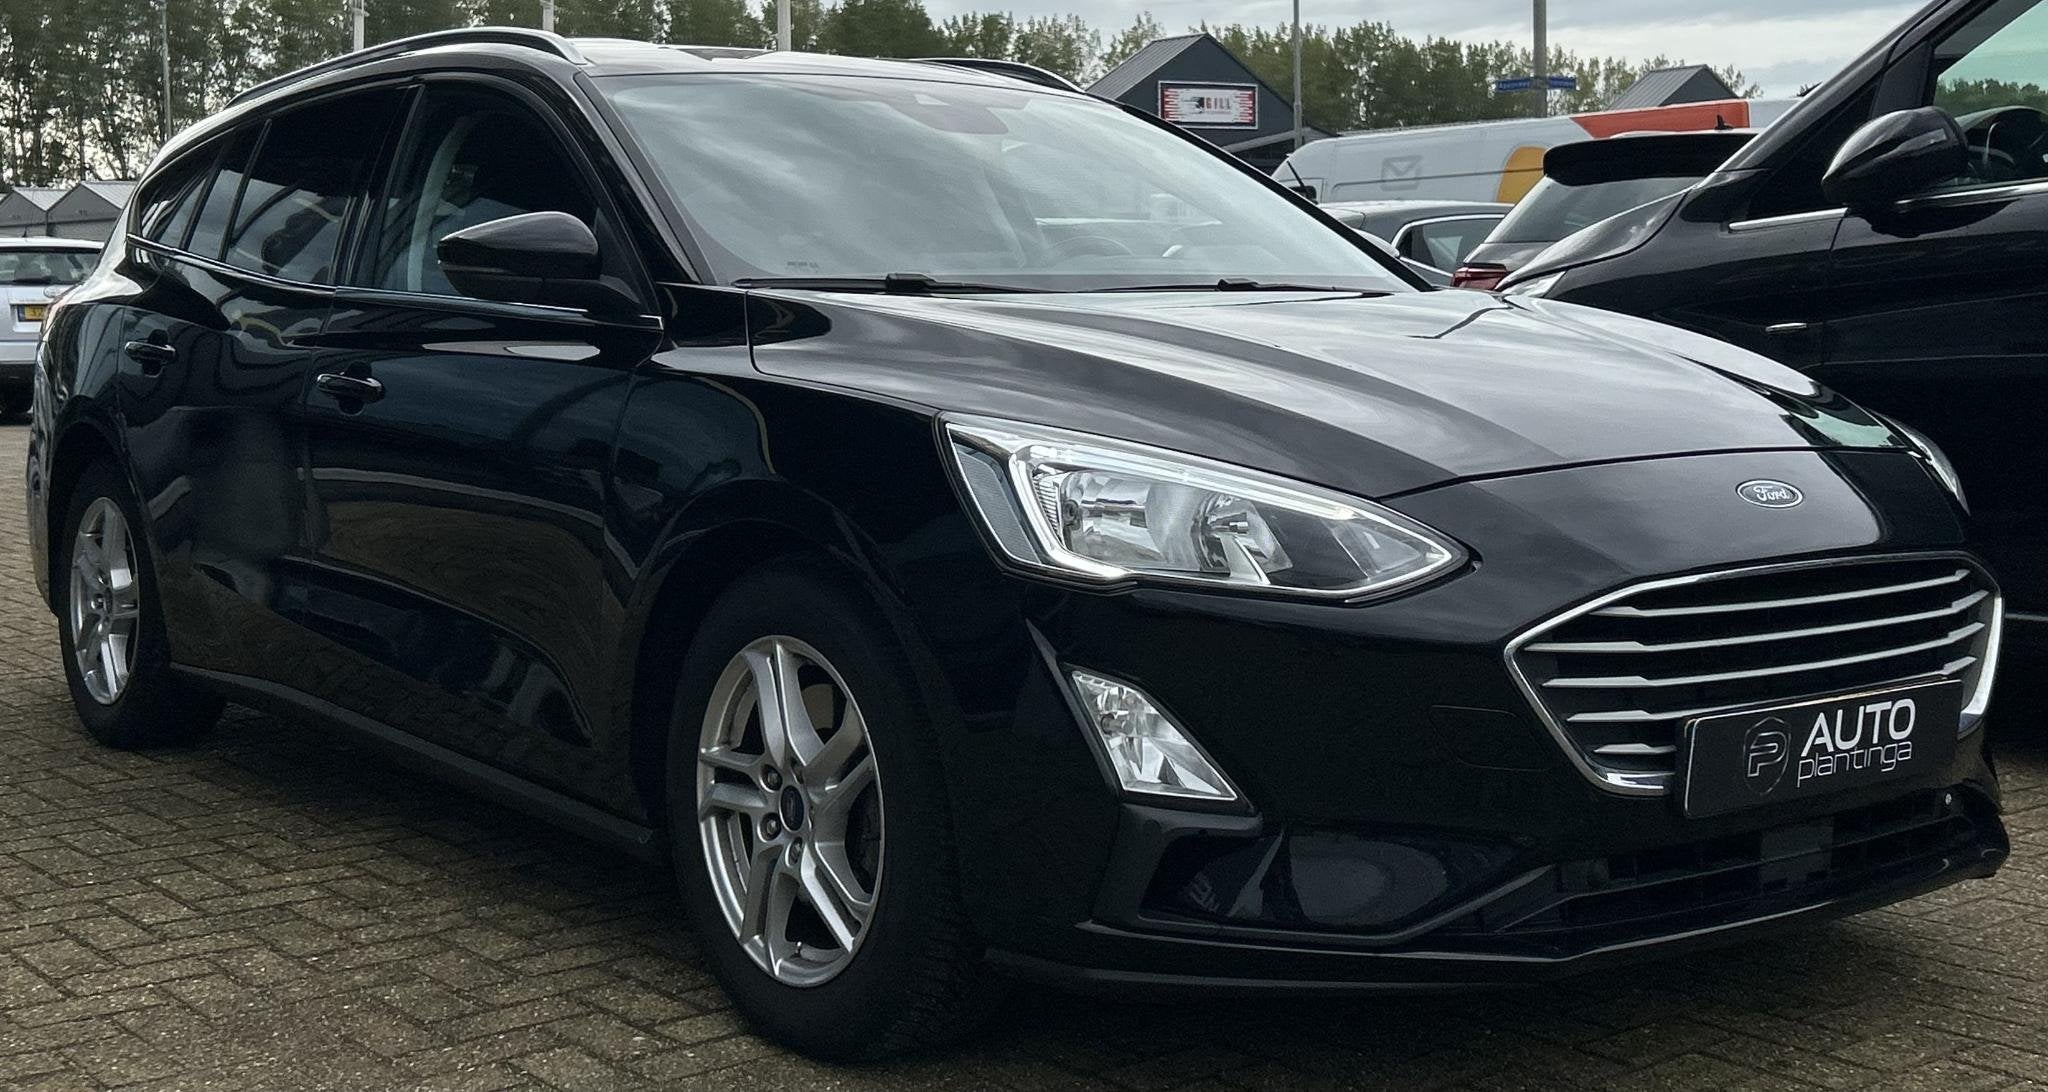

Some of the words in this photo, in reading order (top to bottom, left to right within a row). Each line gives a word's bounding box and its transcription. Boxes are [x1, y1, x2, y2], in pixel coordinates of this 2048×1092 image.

[1753, 485, 1790, 502] Ford
[1800, 698, 1916, 757] AUTO
[1796, 741, 1912, 788] plantinga
